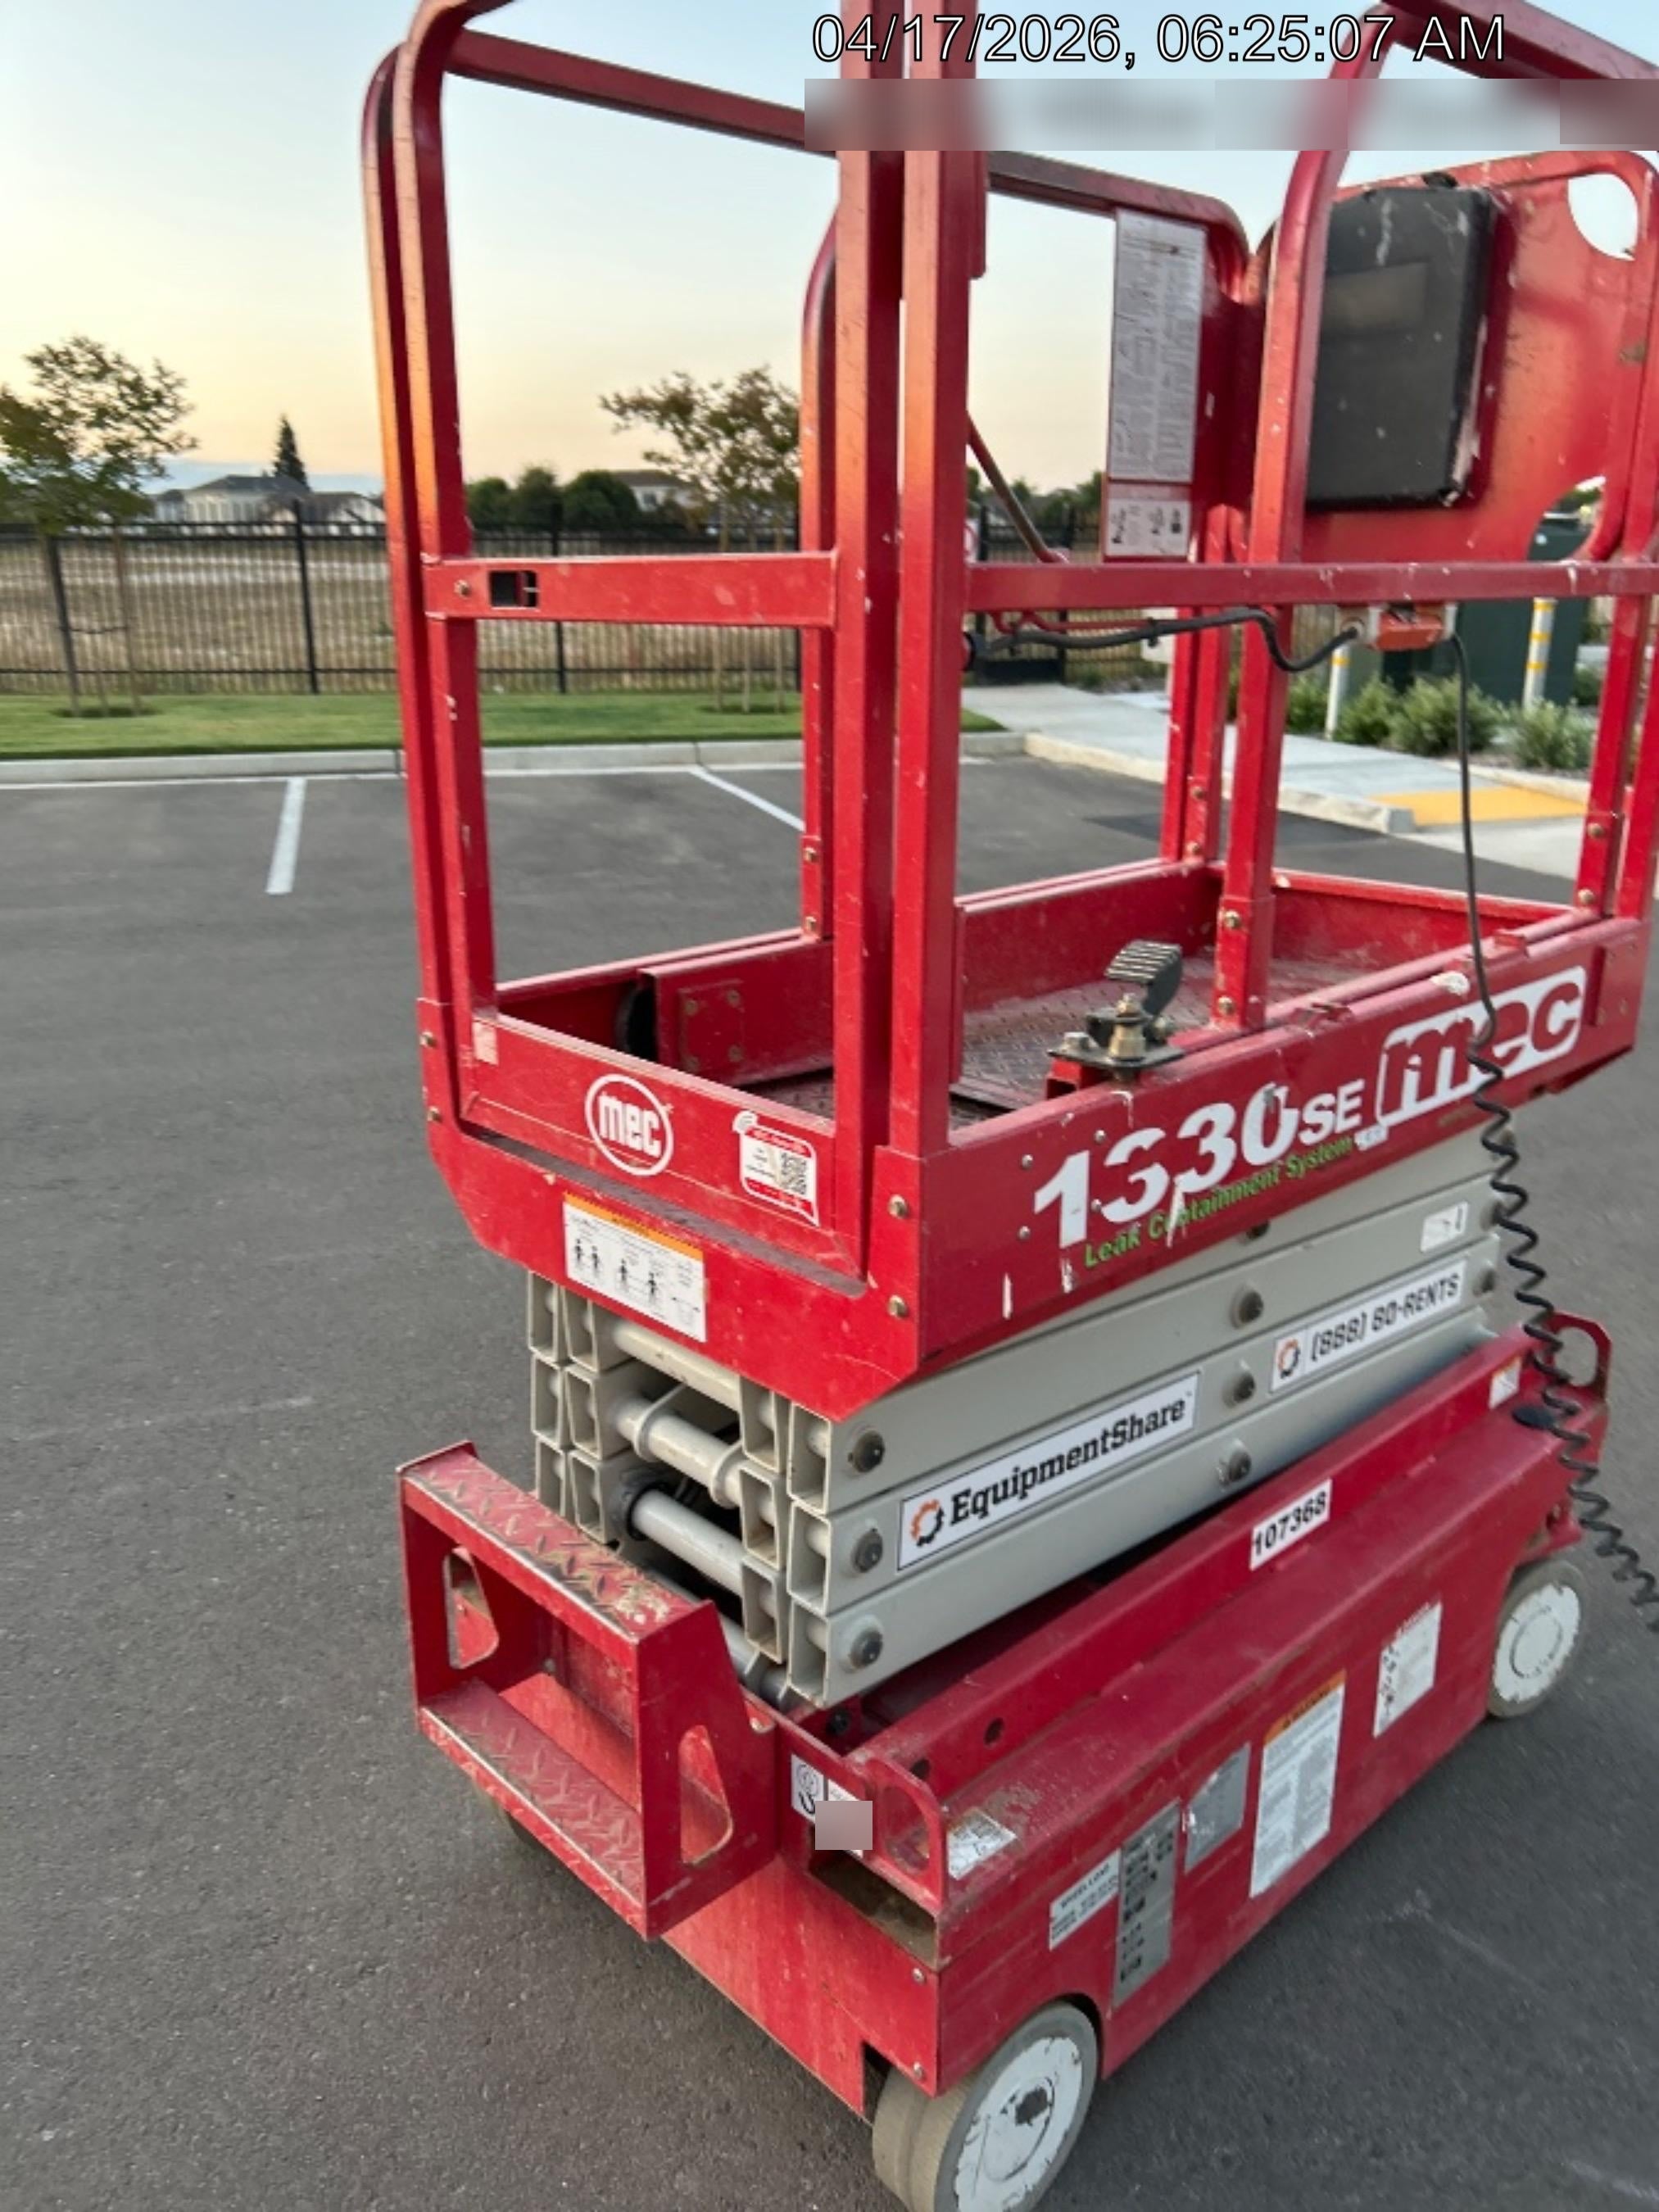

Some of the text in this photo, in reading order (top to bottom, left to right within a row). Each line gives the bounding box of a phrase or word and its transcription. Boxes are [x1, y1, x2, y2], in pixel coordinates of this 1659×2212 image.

[598, 1091, 661, 1158] mec
[1085, 1222, 1140, 1267] Leak
[1285, 1136, 1353, 1179] System
[1311, 1311, 1367, 1362] (888)
[950, 1397, 1185, 1526] EquipmentShare
[1254, 1490, 1326, 1556] 107368
